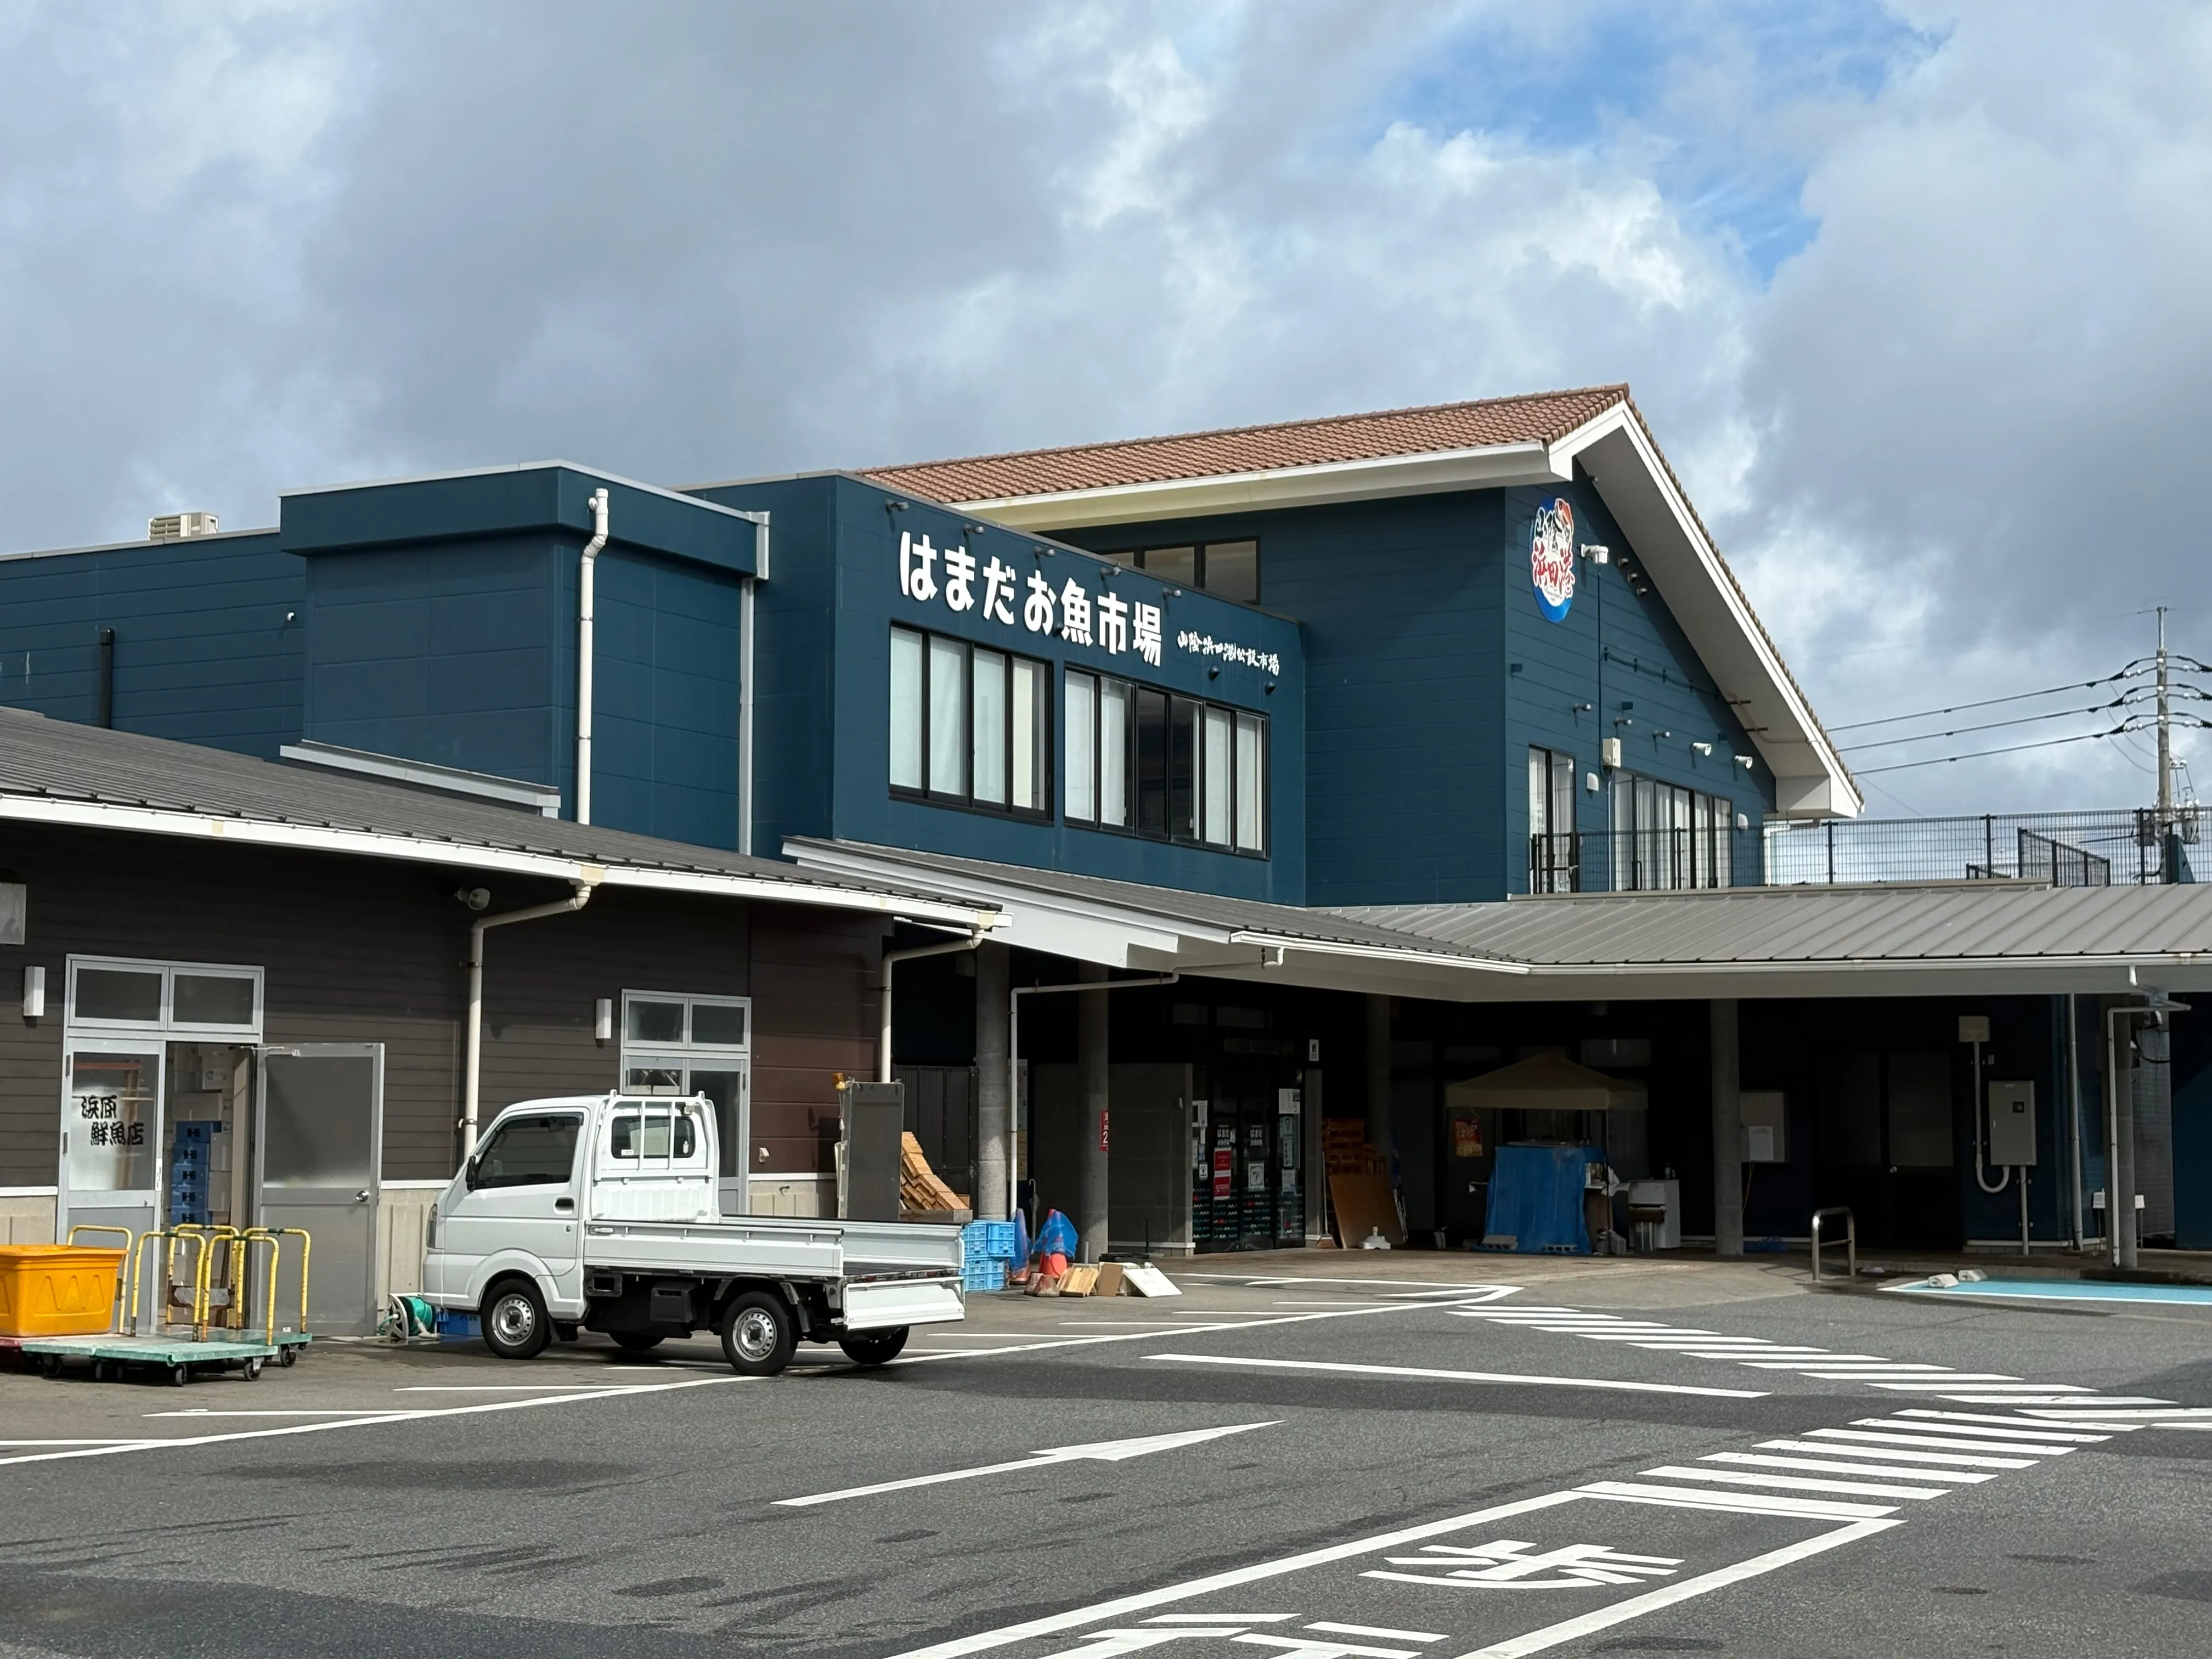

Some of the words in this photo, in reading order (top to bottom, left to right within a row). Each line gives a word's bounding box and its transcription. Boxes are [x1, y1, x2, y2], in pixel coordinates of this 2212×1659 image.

[899, 531, 1163, 667] はまだお魚市場
[1177, 630, 1280, 676] 山陰浜田港公設市場
[81, 1094, 117, 1119] 浜原
[91, 1121, 144, 1146] 鮮魚店
